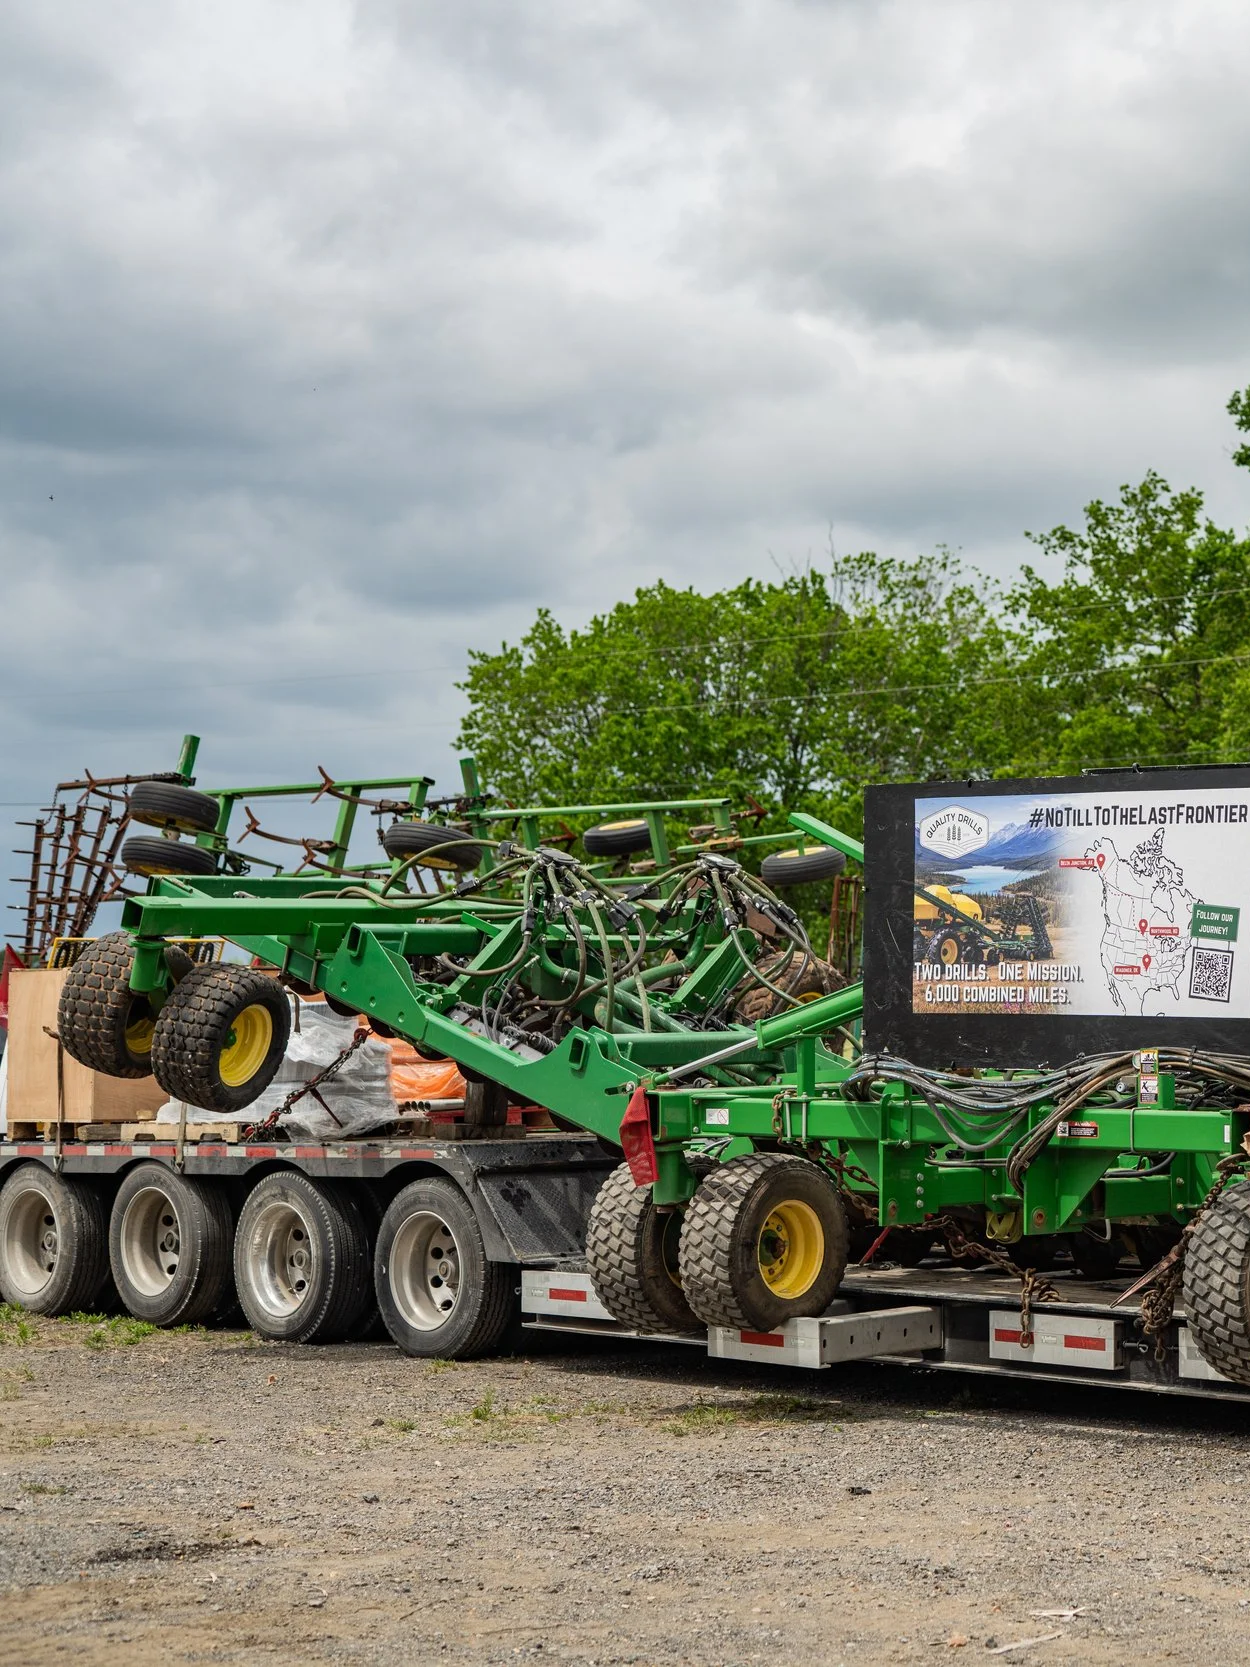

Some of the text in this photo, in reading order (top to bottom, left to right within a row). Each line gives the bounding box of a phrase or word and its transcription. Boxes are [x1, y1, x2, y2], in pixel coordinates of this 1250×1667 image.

[926, 813, 983, 839] QUALITY DRILLS
[1196, 909, 1234, 923] FOLLOW OUR
[1198, 924, 1229, 936] JOURNEY!
[914, 961, 1084, 983] TWO DRILLS. ONE MISSION.
[925, 984, 1071, 1005] 6,000 COMBINED MILES.
